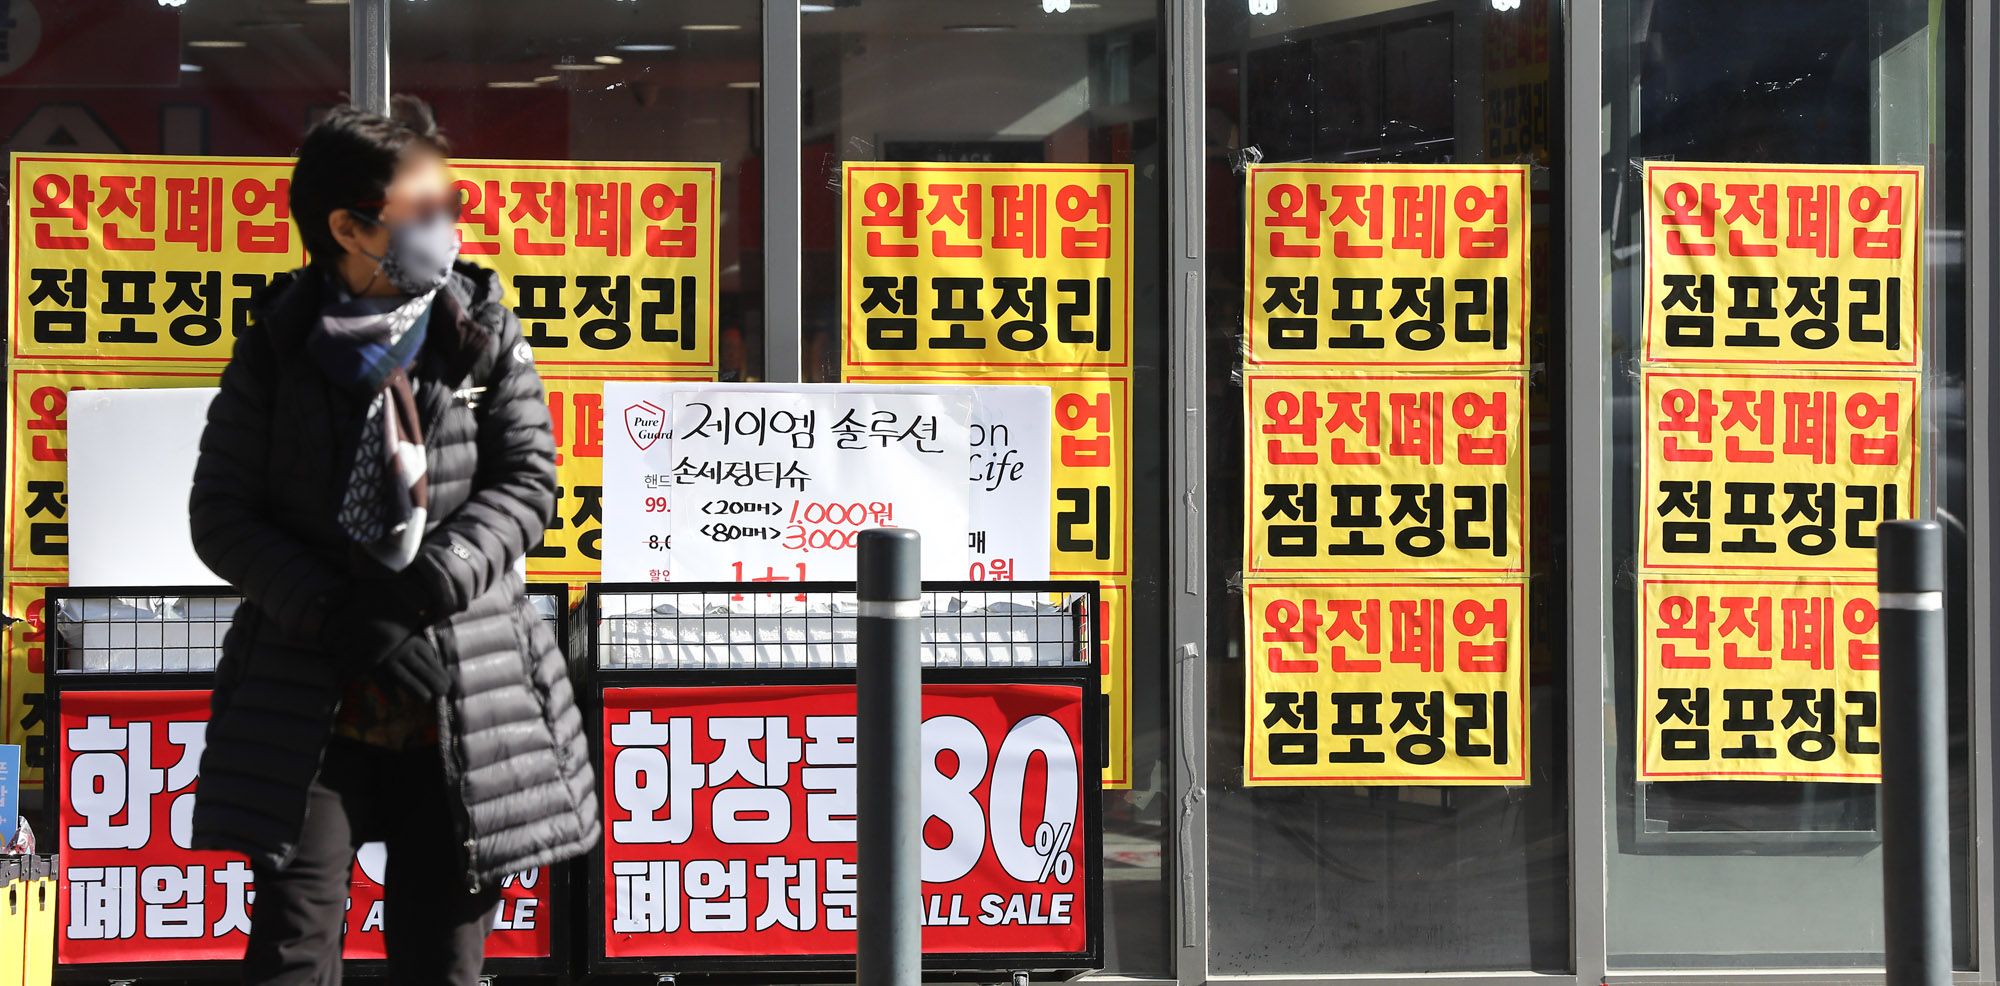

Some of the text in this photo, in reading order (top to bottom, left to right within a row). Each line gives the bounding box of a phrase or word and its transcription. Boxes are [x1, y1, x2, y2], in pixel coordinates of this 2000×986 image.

[29, 174, 291, 254] 완전폐업
[453, 180, 698, 257] 완전폐업
[861, 182, 1112, 258] 완전폐업
[1264, 183, 1509, 259] 완전폐업
[1660, 182, 1902, 259] 완전폐업
[513, 275, 697, 350] 포정리
[860, 276, 1112, 351] 점포정리
[1262, 276, 1508, 351] 점포정리
[1662, 274, 1901, 350] 점포정리
[634, 417, 659, 427] Pure
[638, 430, 673, 440] Guard
[681, 402, 944, 453] 제이엠 솔루션
[1262, 391, 1507, 465] 완전폐업
[1658, 388, 1899, 465] 완전폐업
[672, 456, 812, 492] 손세정티슈
[701, 500, 783, 516] <20매>
[969, 449, 1025, 492] Life
[699, 523, 781, 542] <80매>
[1262, 482, 1508, 558] 점포정리
[1657, 480, 1898, 556] 점포정리
[731, 561, 807, 602] 1+1
[1262, 598, 1508, 674] 완전폐업
[1655, 595, 1880, 670] 완전폐업
[1262, 690, 1508, 765] 점포정리
[610, 711, 857, 844] 화장품
[66, 861, 256, 940] 폐업처
[492, 898, 539, 930] LE
[977, 893, 1074, 926] SALE
